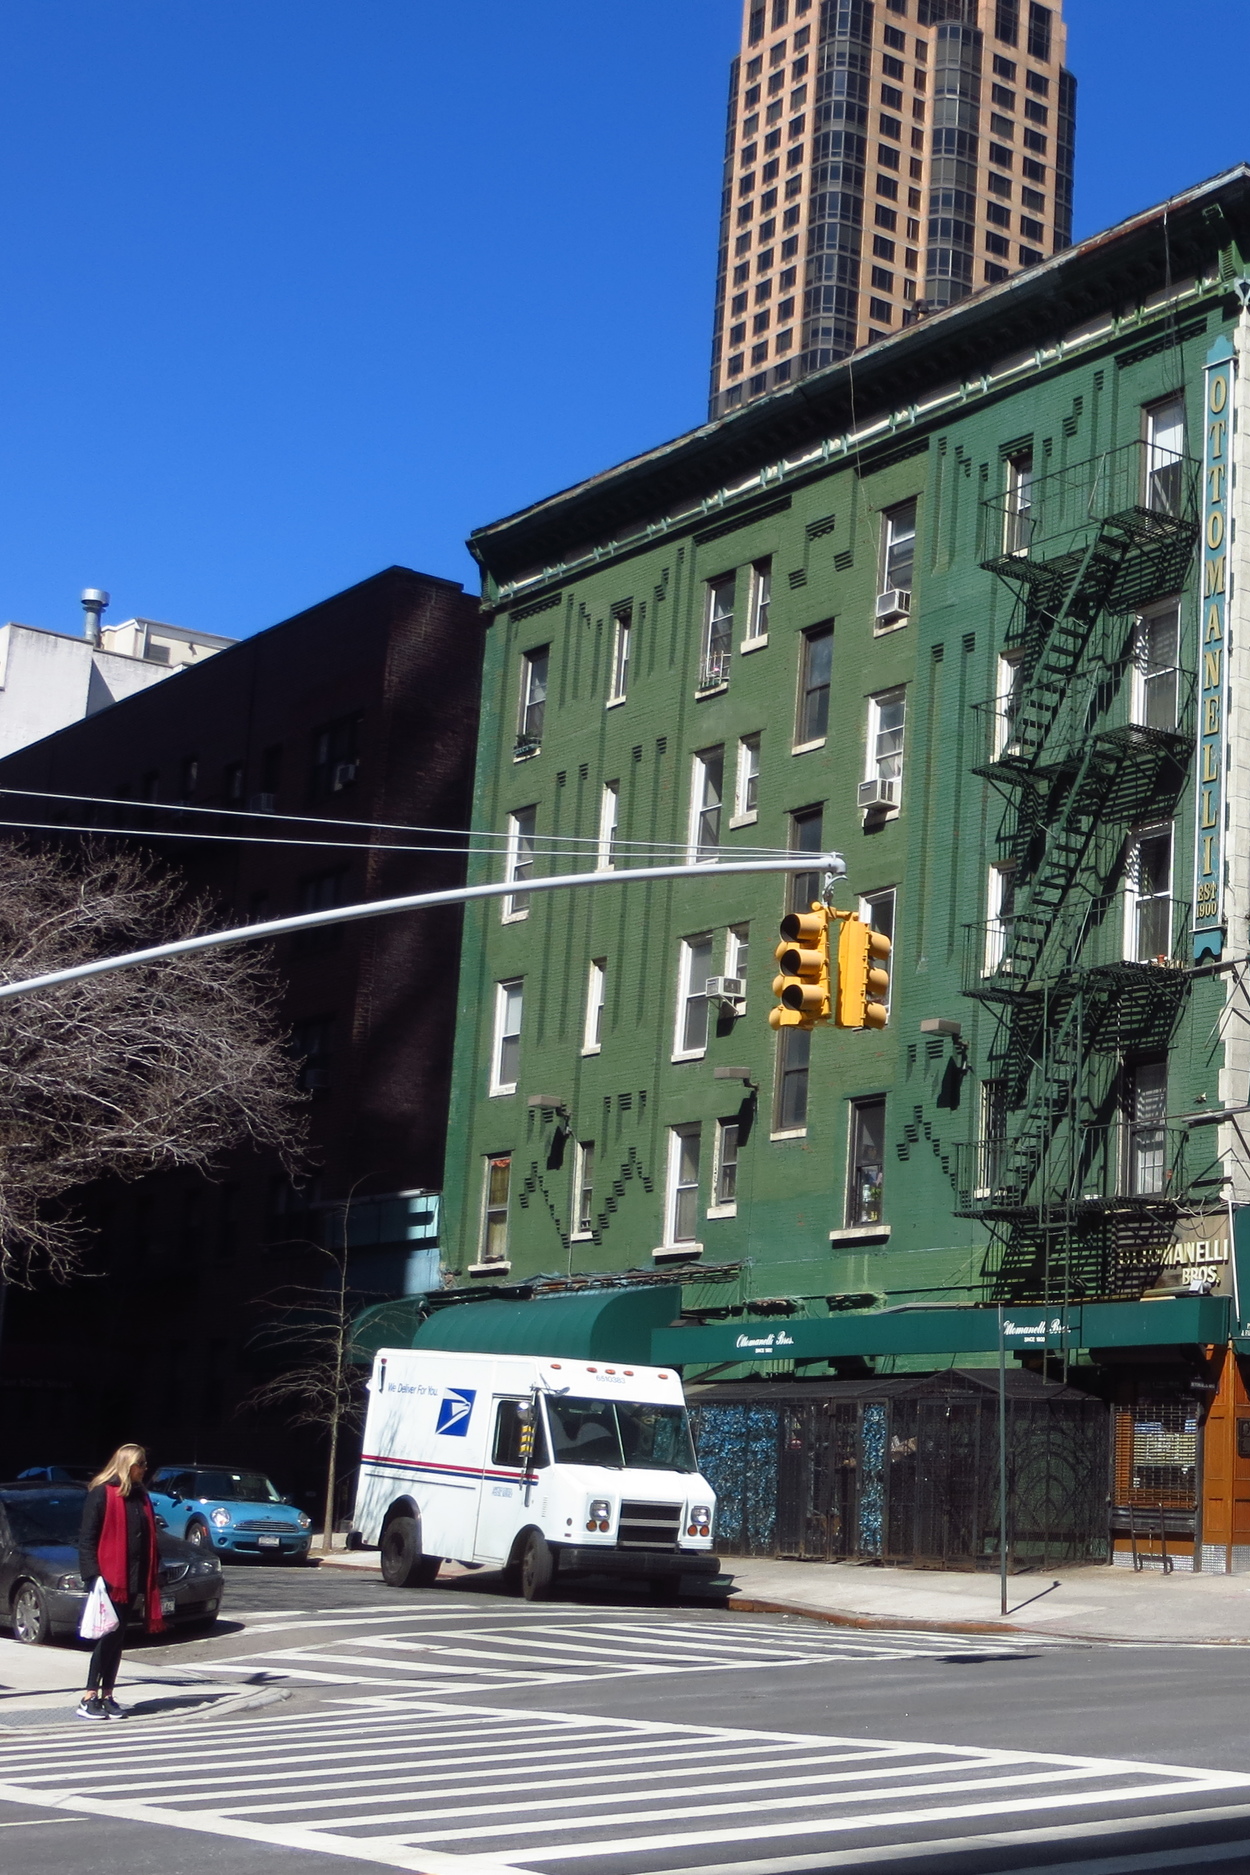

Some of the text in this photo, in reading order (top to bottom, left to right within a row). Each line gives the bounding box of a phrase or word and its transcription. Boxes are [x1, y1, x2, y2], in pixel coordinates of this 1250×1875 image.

[1202, 375, 1227, 875] OTTOMANELLI
[1196, 902, 1217, 918] 1900
[595, 1374, 626, 1385] 6510383
[388, 1382, 438, 1396] We Deliver For You.
